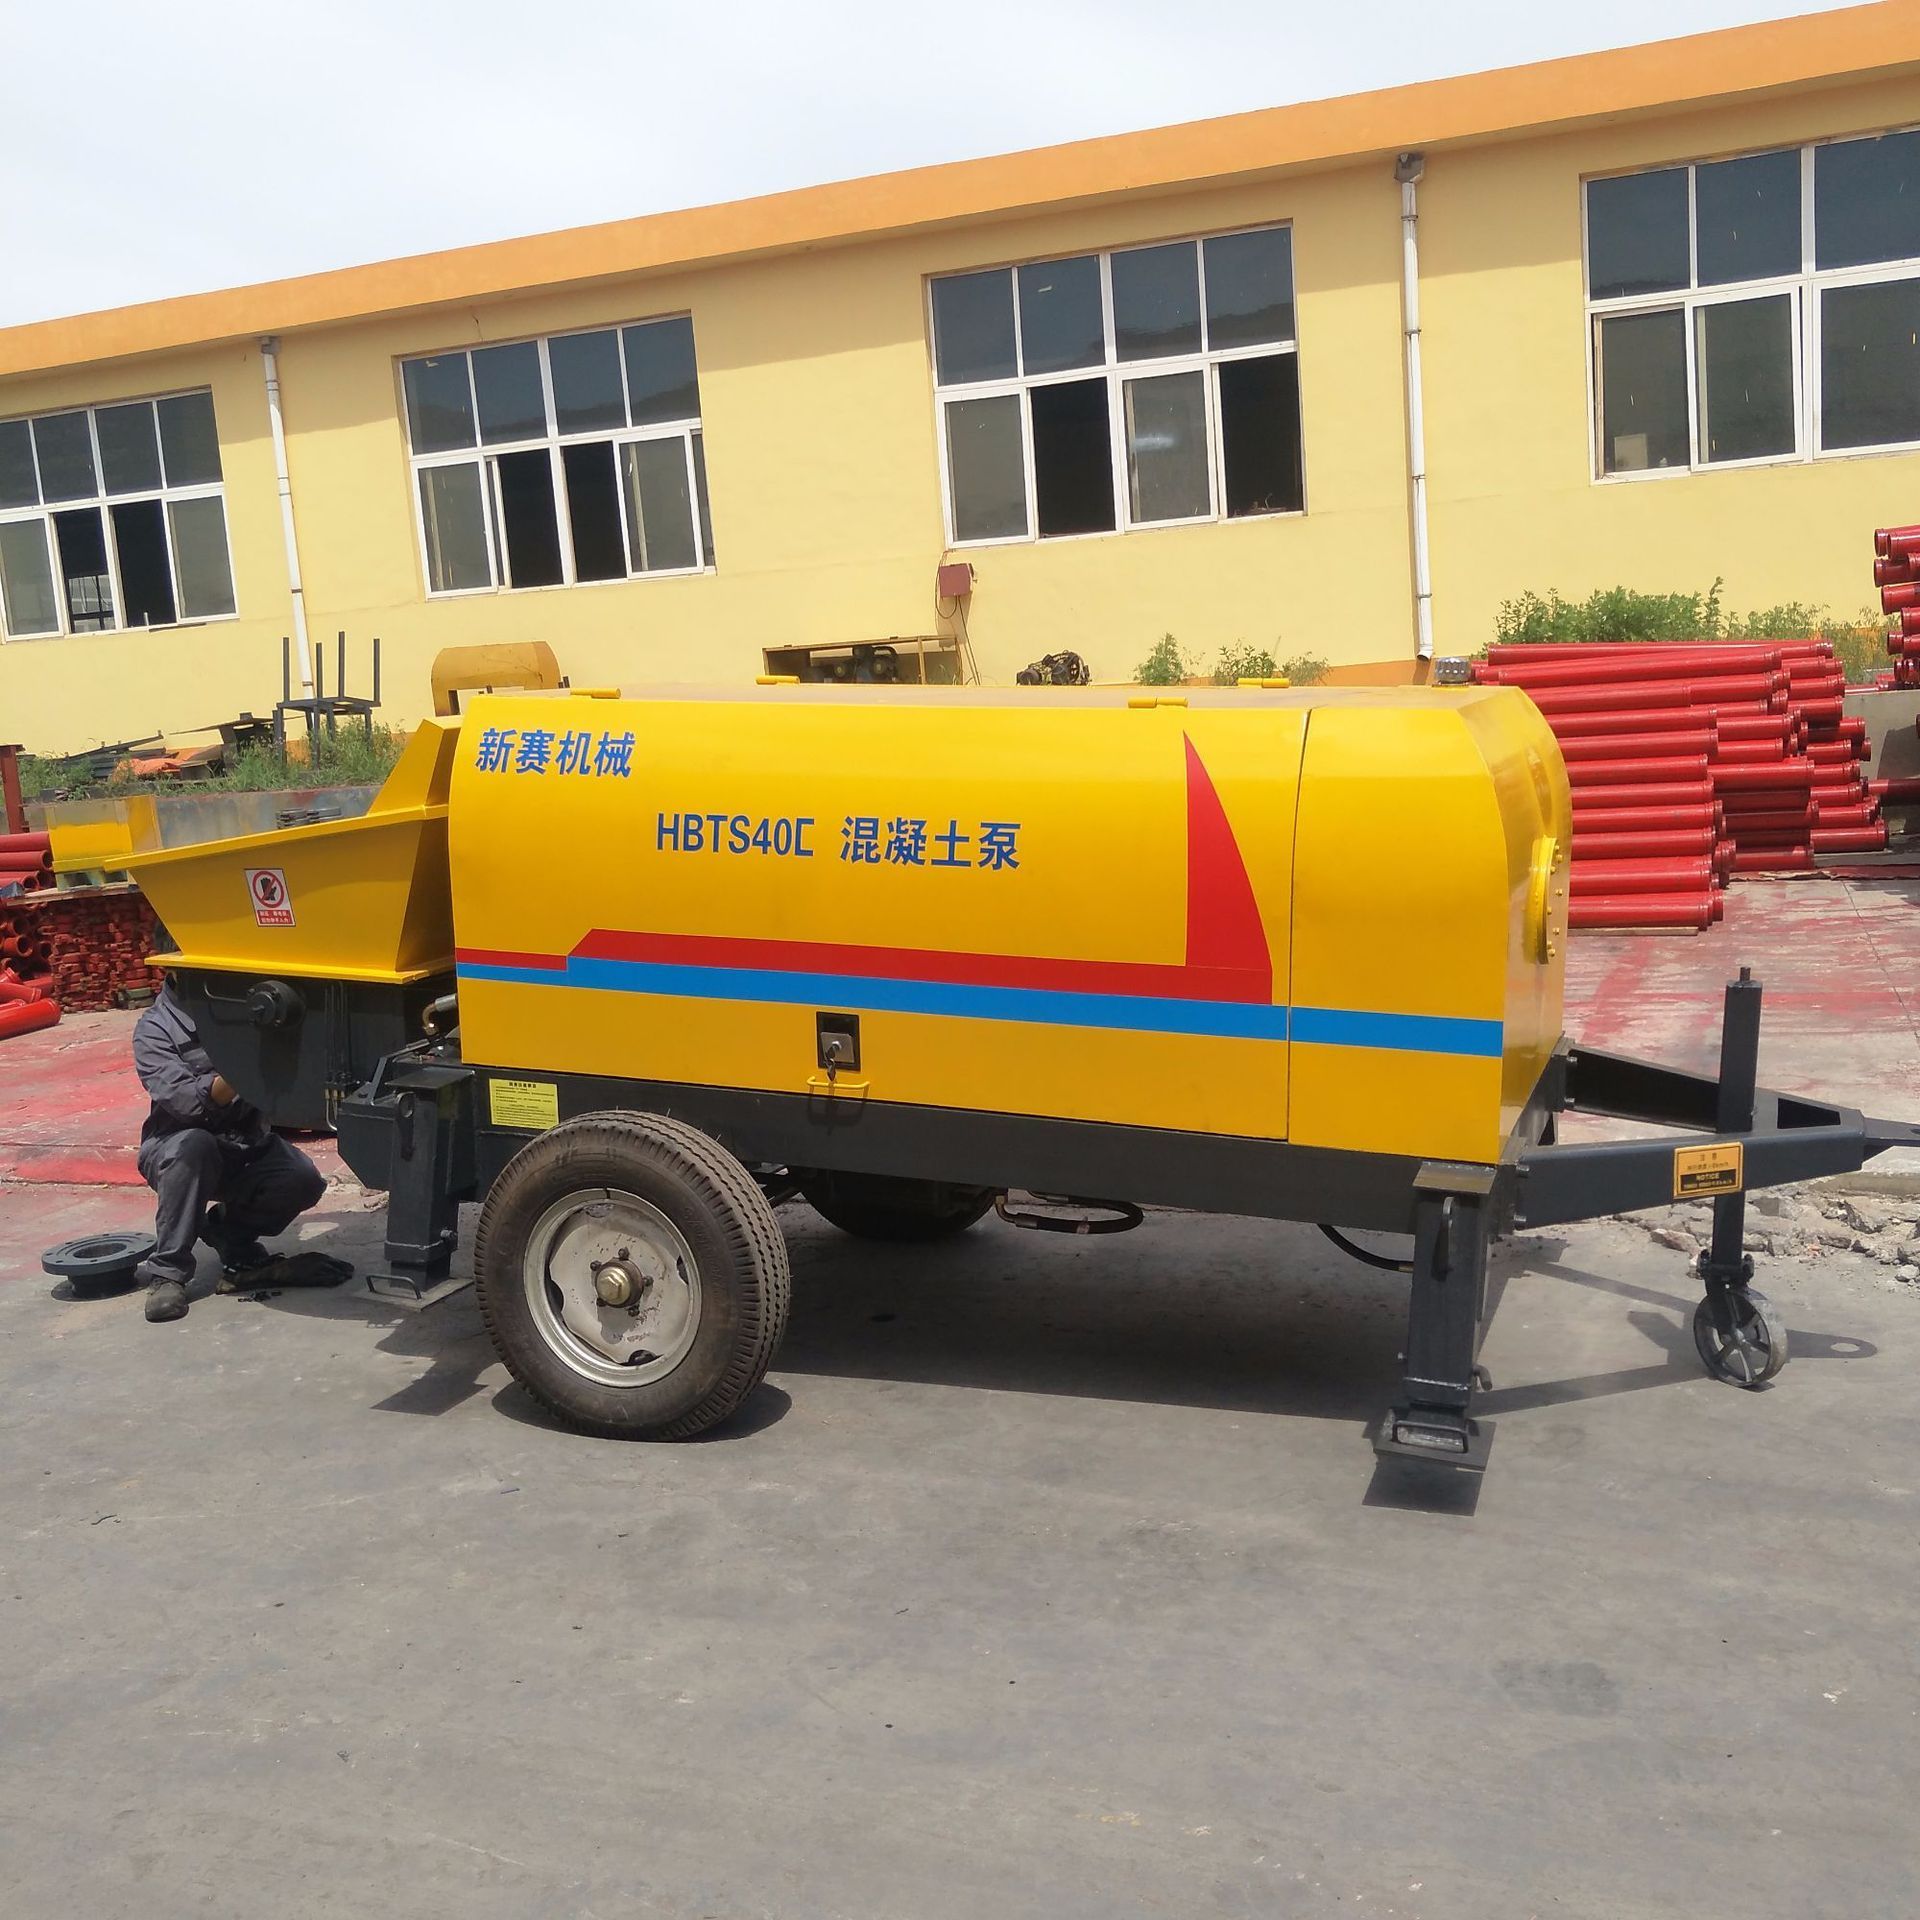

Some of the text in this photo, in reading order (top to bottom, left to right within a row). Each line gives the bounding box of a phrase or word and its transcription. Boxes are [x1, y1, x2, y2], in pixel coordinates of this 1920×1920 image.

[475, 728, 635, 778] 新赛机械
[840, 815, 1021, 871] 混凝土泵
